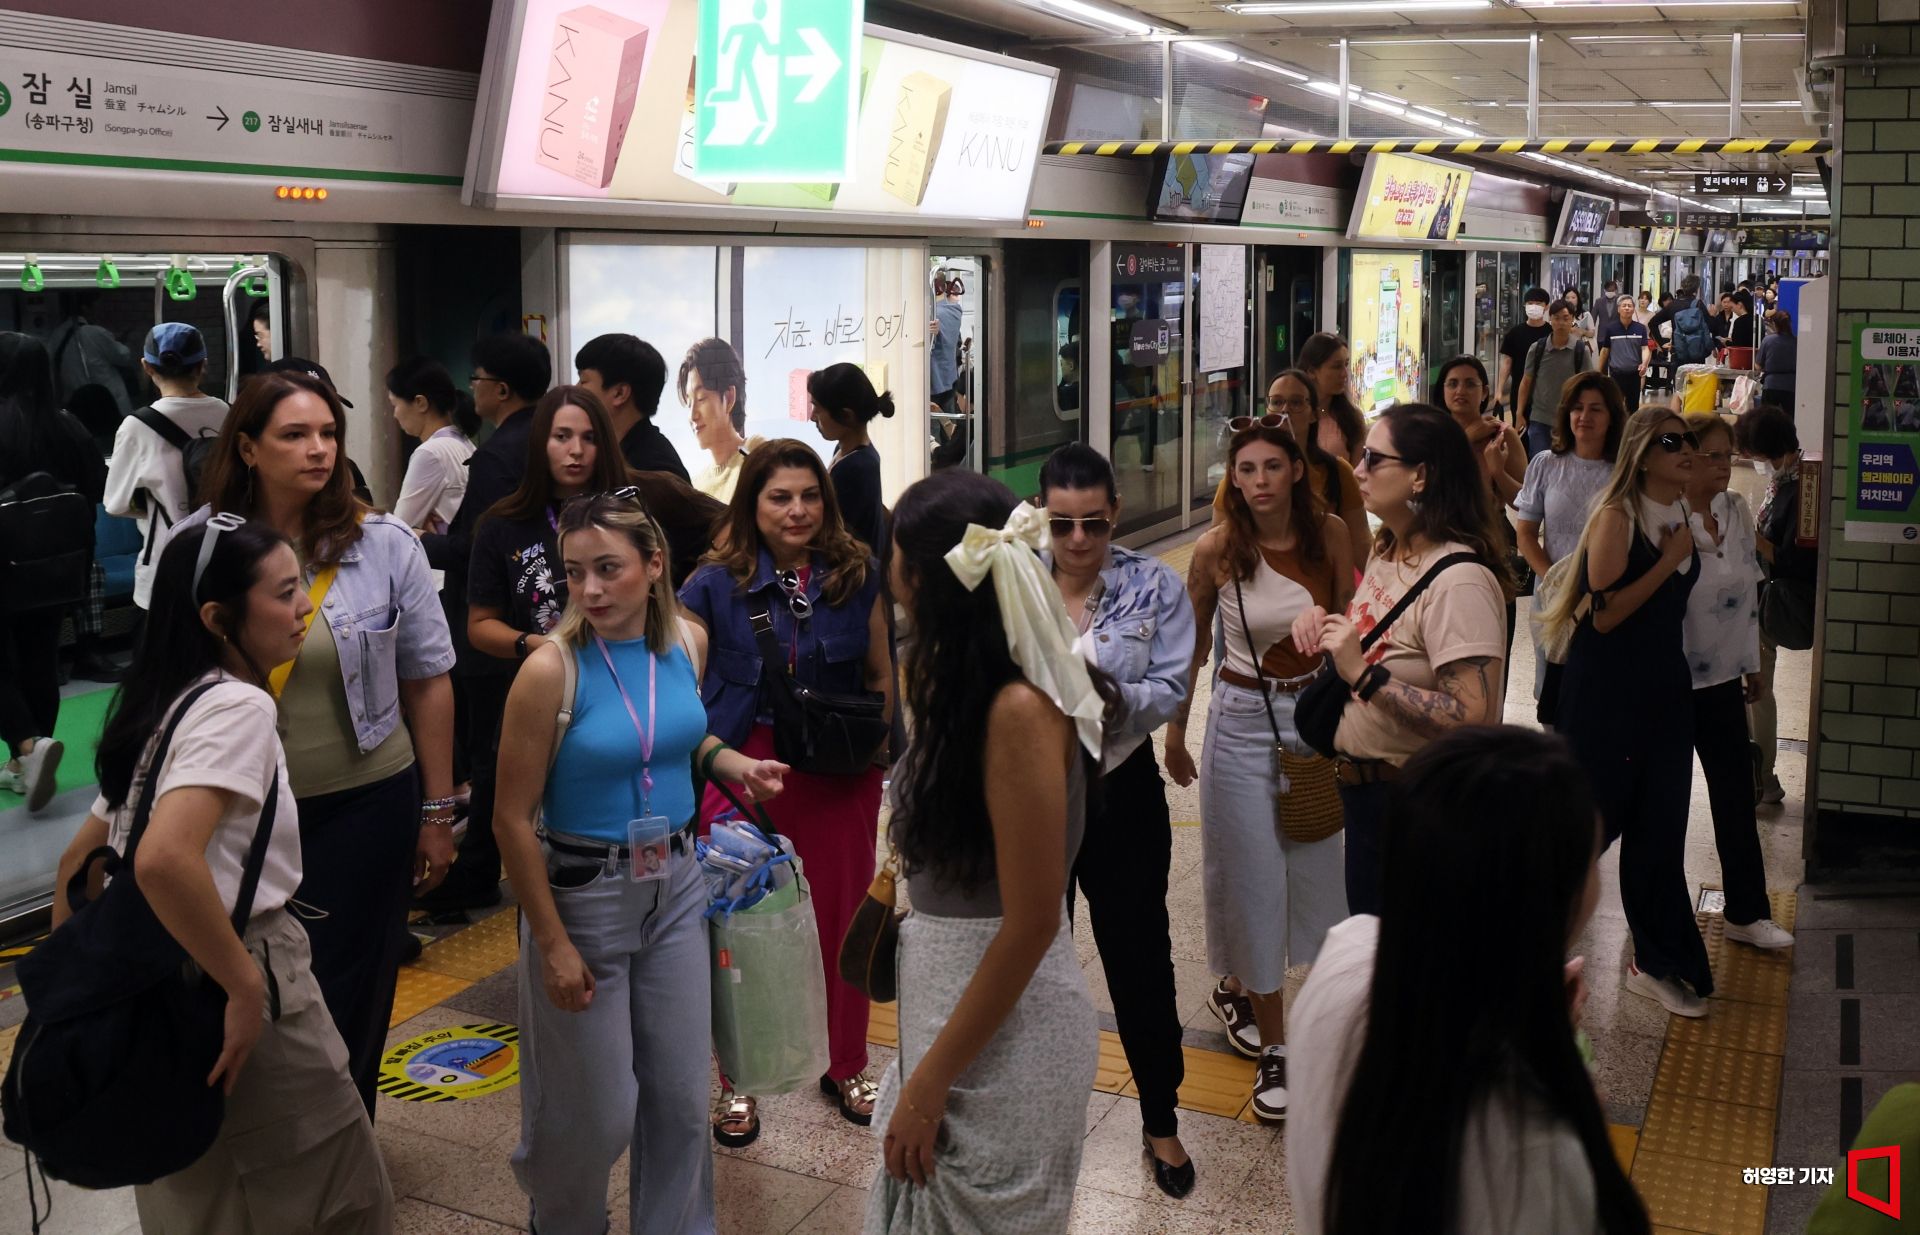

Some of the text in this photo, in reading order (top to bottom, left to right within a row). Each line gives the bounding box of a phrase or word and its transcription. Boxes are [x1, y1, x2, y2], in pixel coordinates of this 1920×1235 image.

[104, 81, 137, 95] Jamsil
[137, 102, 187, 116] チャムシル
[25, 112, 94, 134] (송파구청)
[244, 117, 258, 126] 217
[267, 114, 323, 136] 잠실새내
[104, 123, 148, 136] (Songpa-gu
[958, 132, 1025, 172] KANU
[1703, 176, 1748, 186] 엘리베이터
[1267, 269, 1273, 287] 7
[824, 303, 865, 346] 바로.
[875, 300, 908, 348] 여기.
[1872, 332, 1907, 344] 휠체어
[1887, 346, 1919, 357] 이용자
[1862, 454, 1894, 466] 우리역
[1861, 471, 1914, 485] 엘리베이터
[1860, 489, 1903, 502] 위치안내
